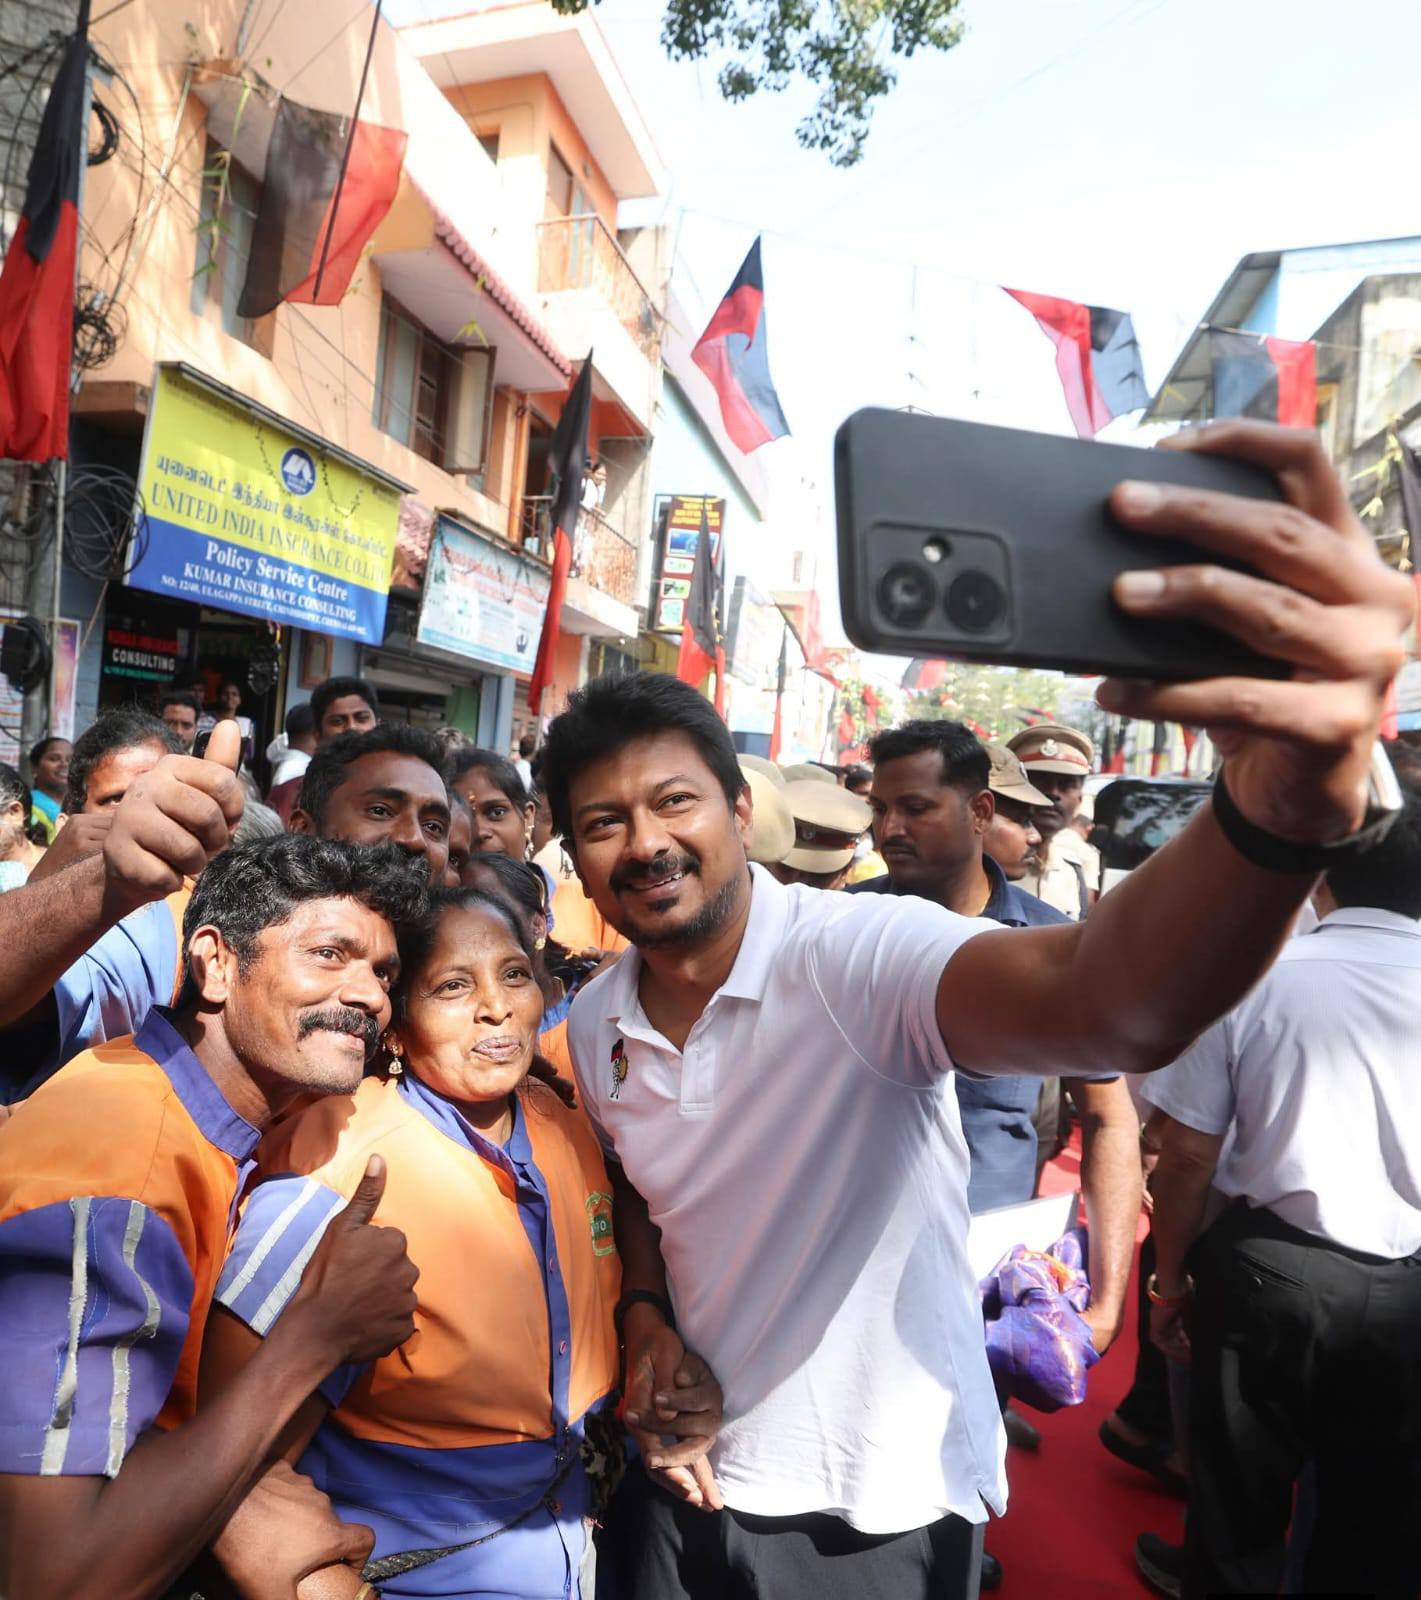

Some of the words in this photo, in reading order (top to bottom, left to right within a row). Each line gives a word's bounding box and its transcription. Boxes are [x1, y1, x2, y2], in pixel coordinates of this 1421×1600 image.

[152, 482, 218, 525] UNITED
[222, 508, 265, 541] INDIA
[270, 525, 342, 569] INSURANCE
[184, 562, 231, 589] KUMAR
[234, 576, 297, 605] INSURANCE
[298, 595, 357, 622] CONSULTING
[206, 541, 253, 576] Policy
[256, 557, 305, 588] Service
[308, 574, 348, 601] Centre
[112, 647, 175, 672] CONSULTING
